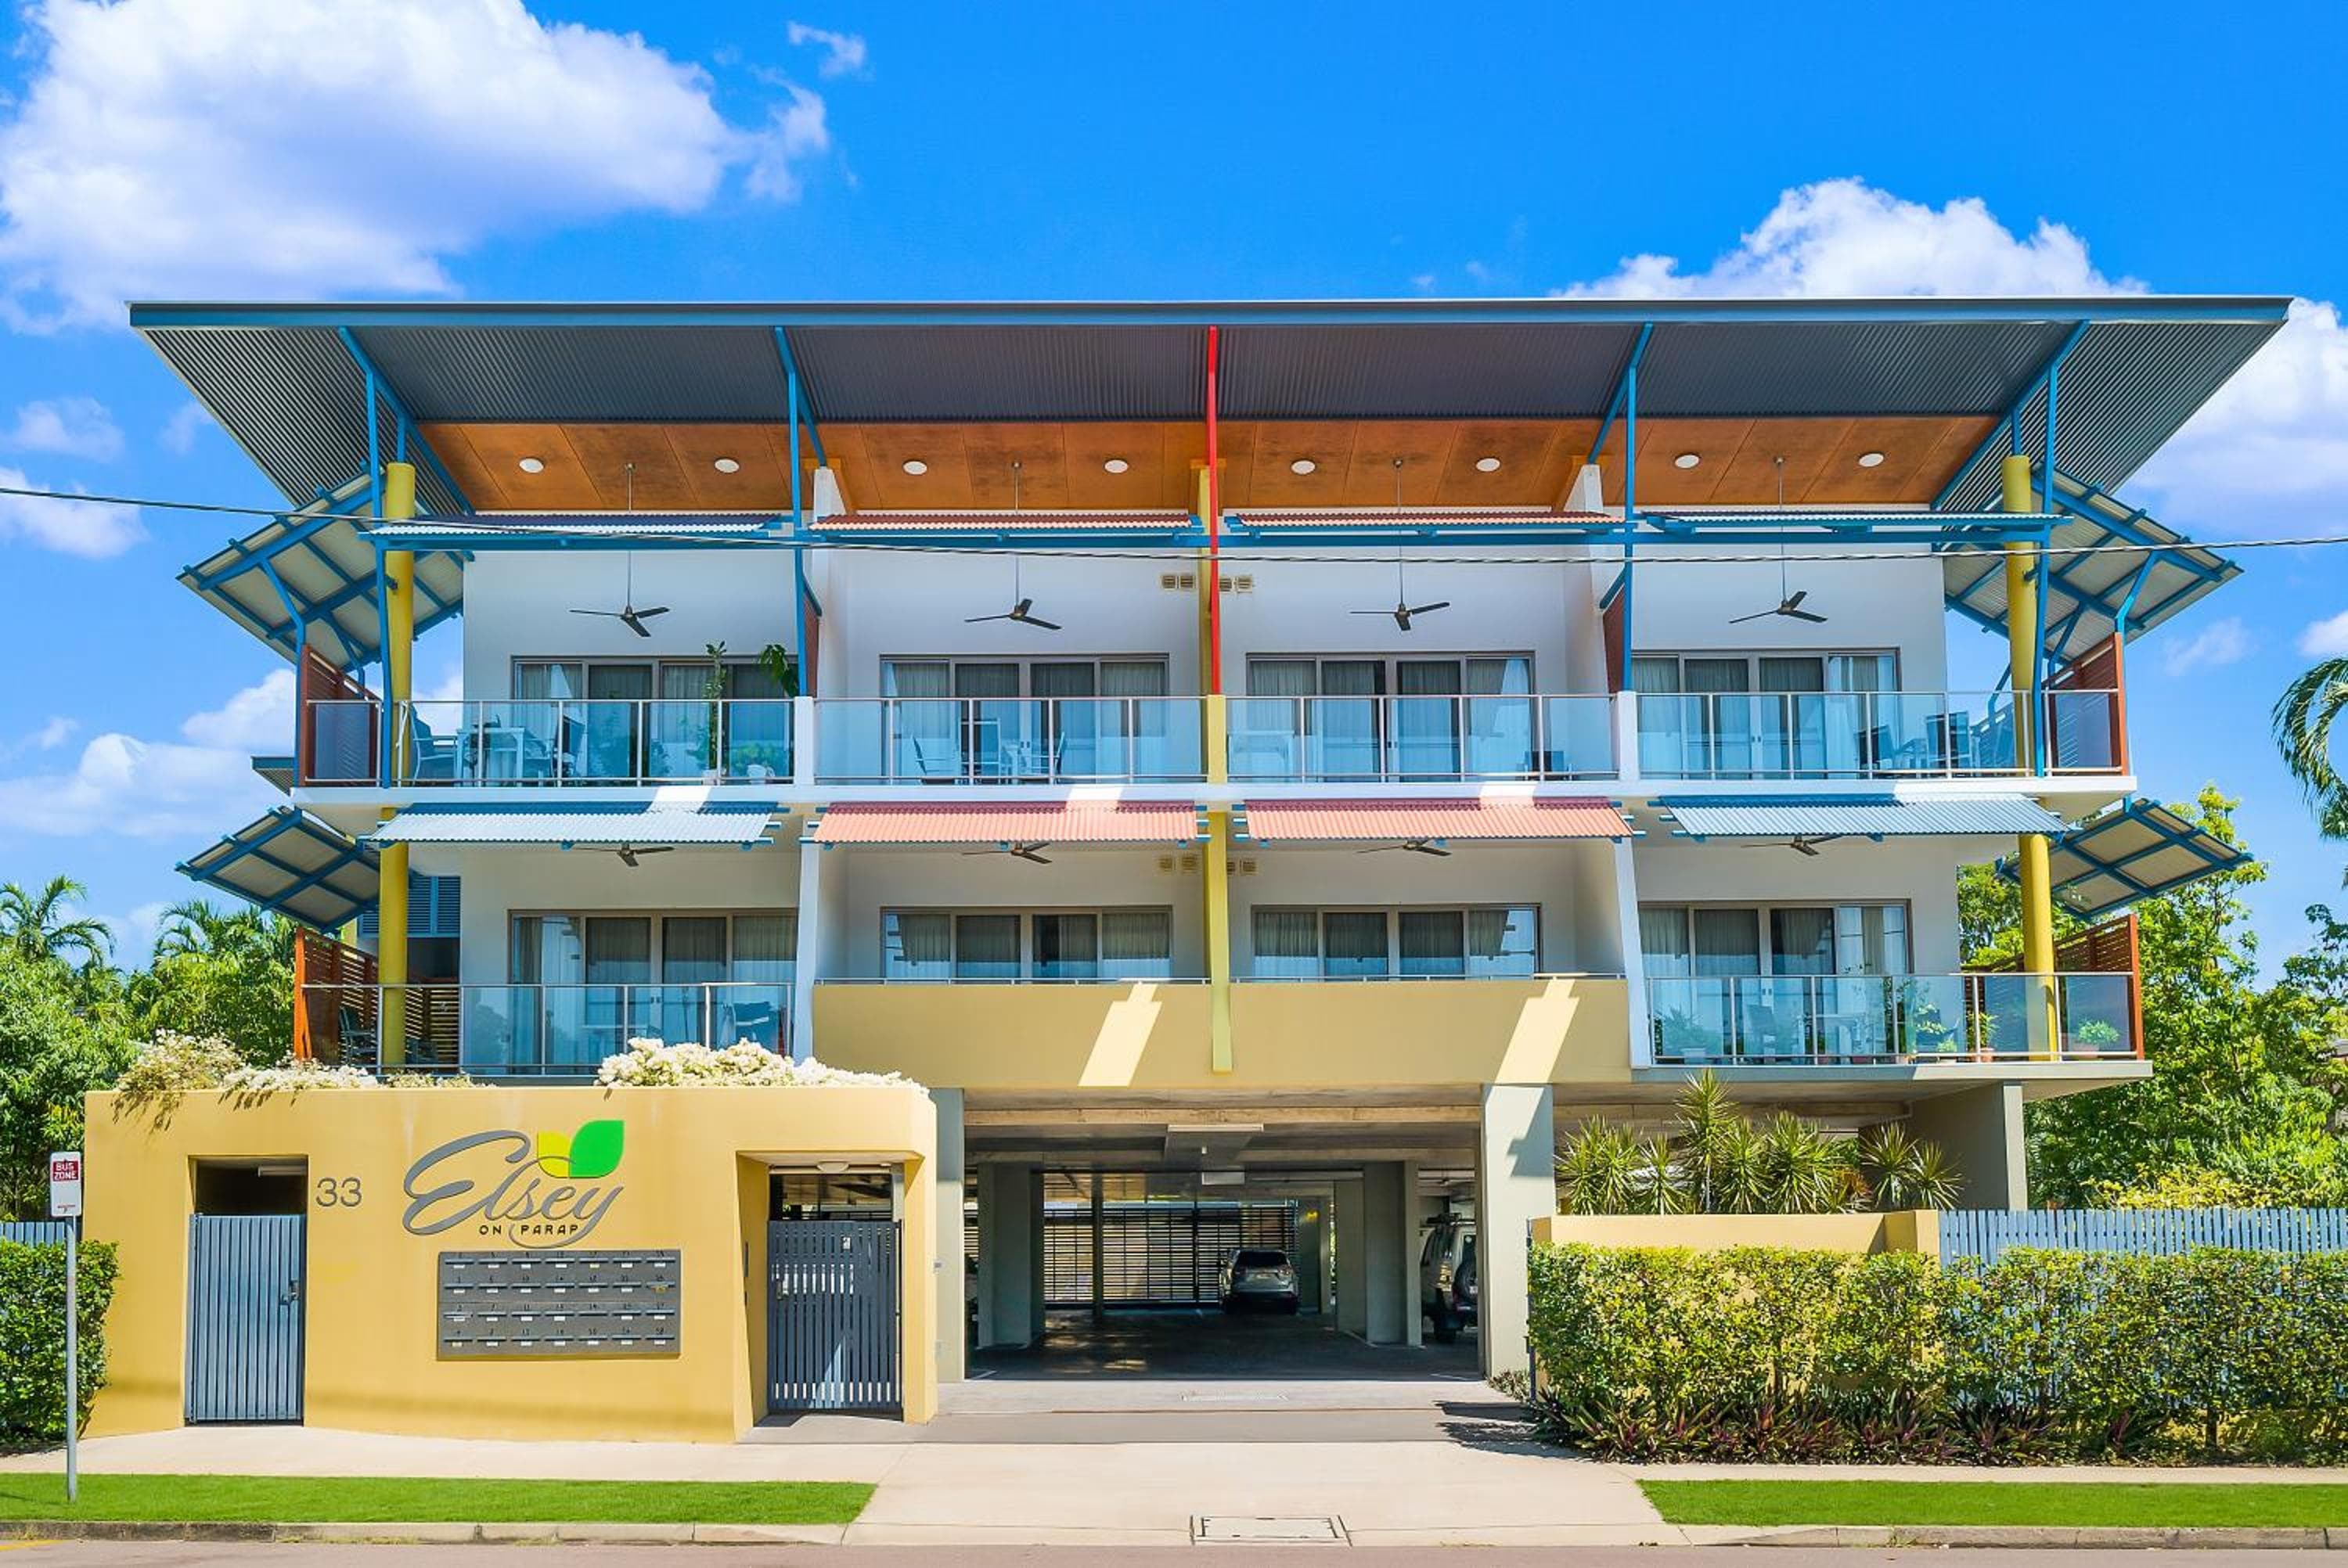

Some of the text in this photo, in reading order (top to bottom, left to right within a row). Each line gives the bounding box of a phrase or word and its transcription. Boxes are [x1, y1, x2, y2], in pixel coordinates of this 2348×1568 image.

[56, 1163, 74, 1171] BUS
[54, 1171, 77, 1180] ZONE
[316, 1178, 362, 1207] 33
[402, 1129, 624, 1249] Elsey
[479, 1225, 578, 1235] ON PARAP
